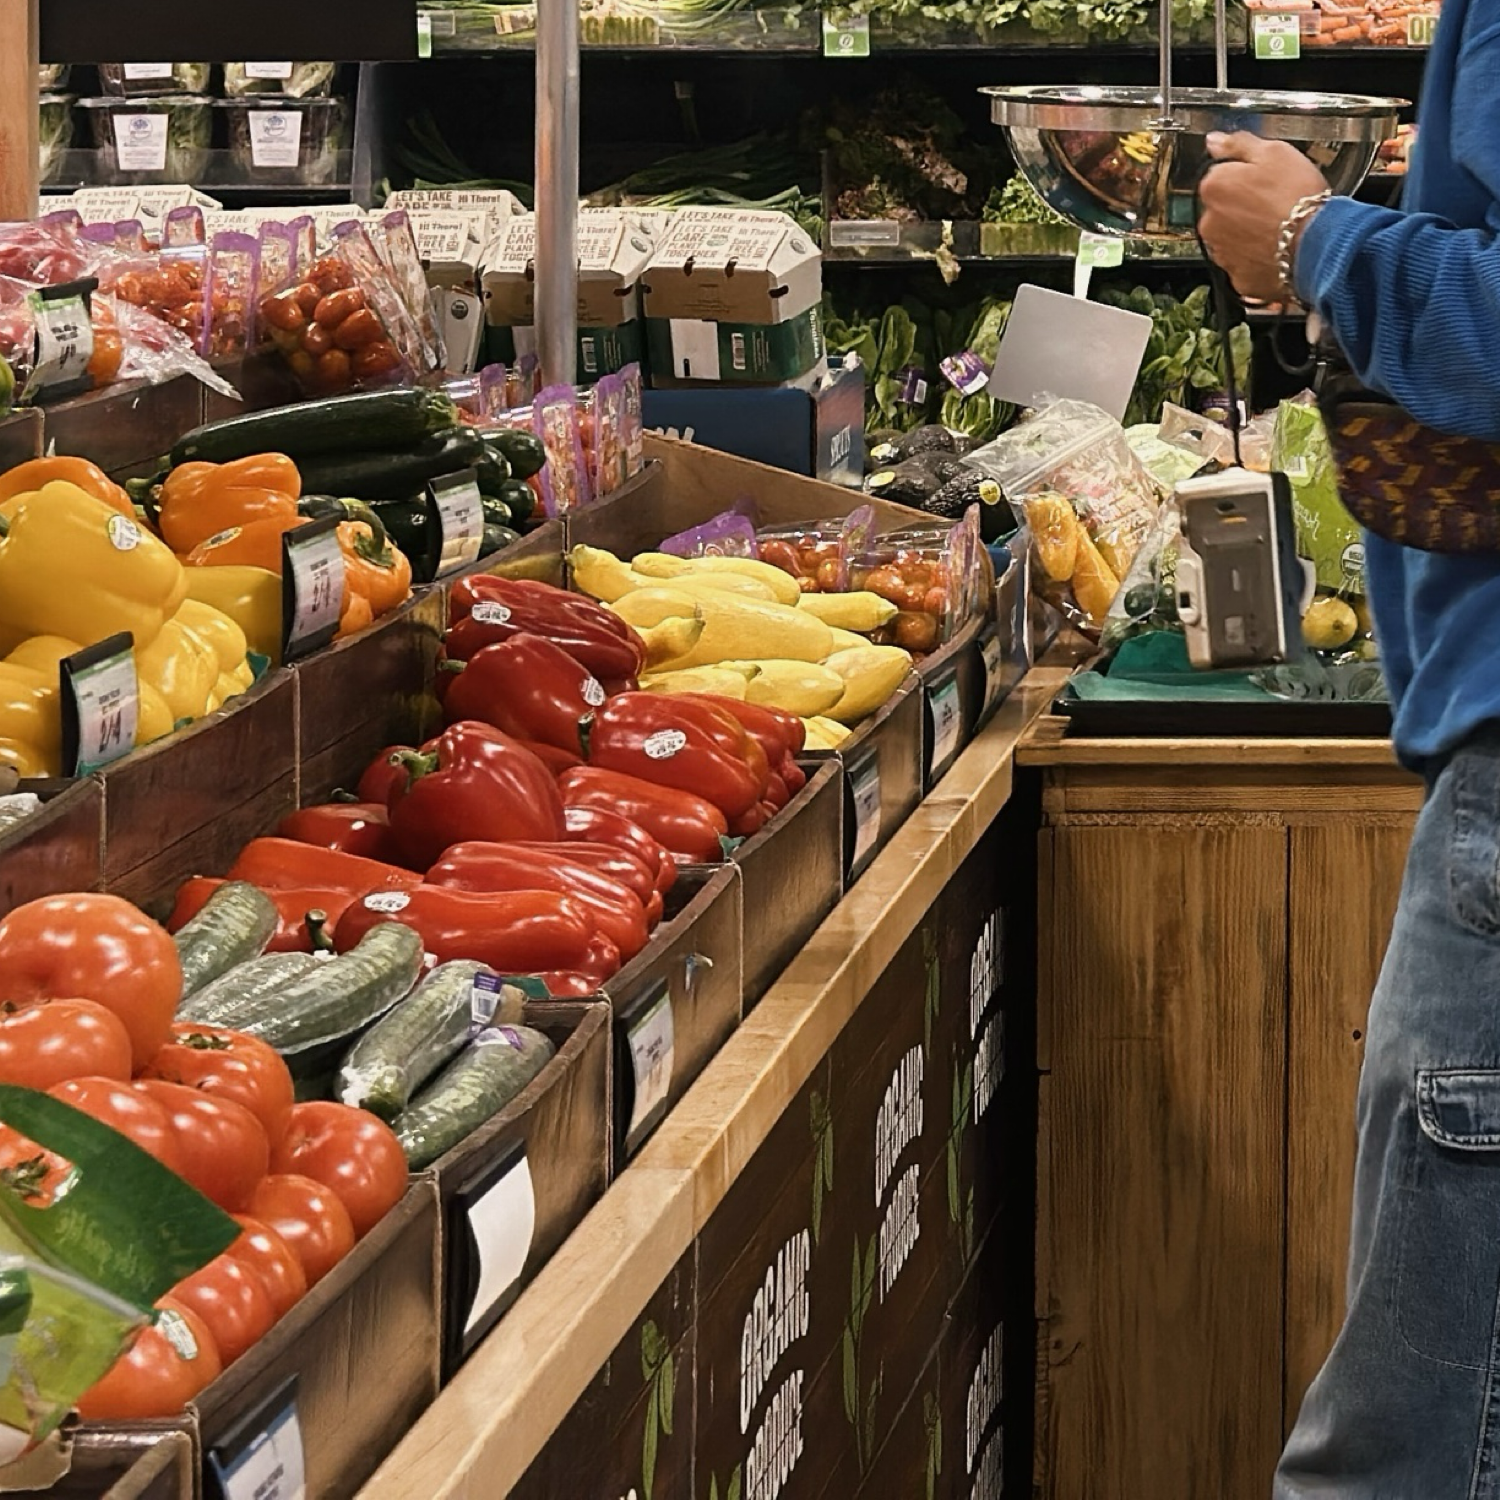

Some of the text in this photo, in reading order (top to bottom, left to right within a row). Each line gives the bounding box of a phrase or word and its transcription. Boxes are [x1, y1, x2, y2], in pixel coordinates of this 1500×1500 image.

[580, 16, 656, 44] GANIC
[427, 191, 453, 201] TAKE
[507, 233, 536, 245] CAR
[875, 1043, 924, 1207] ORGANIC
[880, 1163, 921, 1304] PRODUCE
[740, 1227, 811, 1435] ORGANIC
[746, 1369, 804, 1500] PRODUCE
